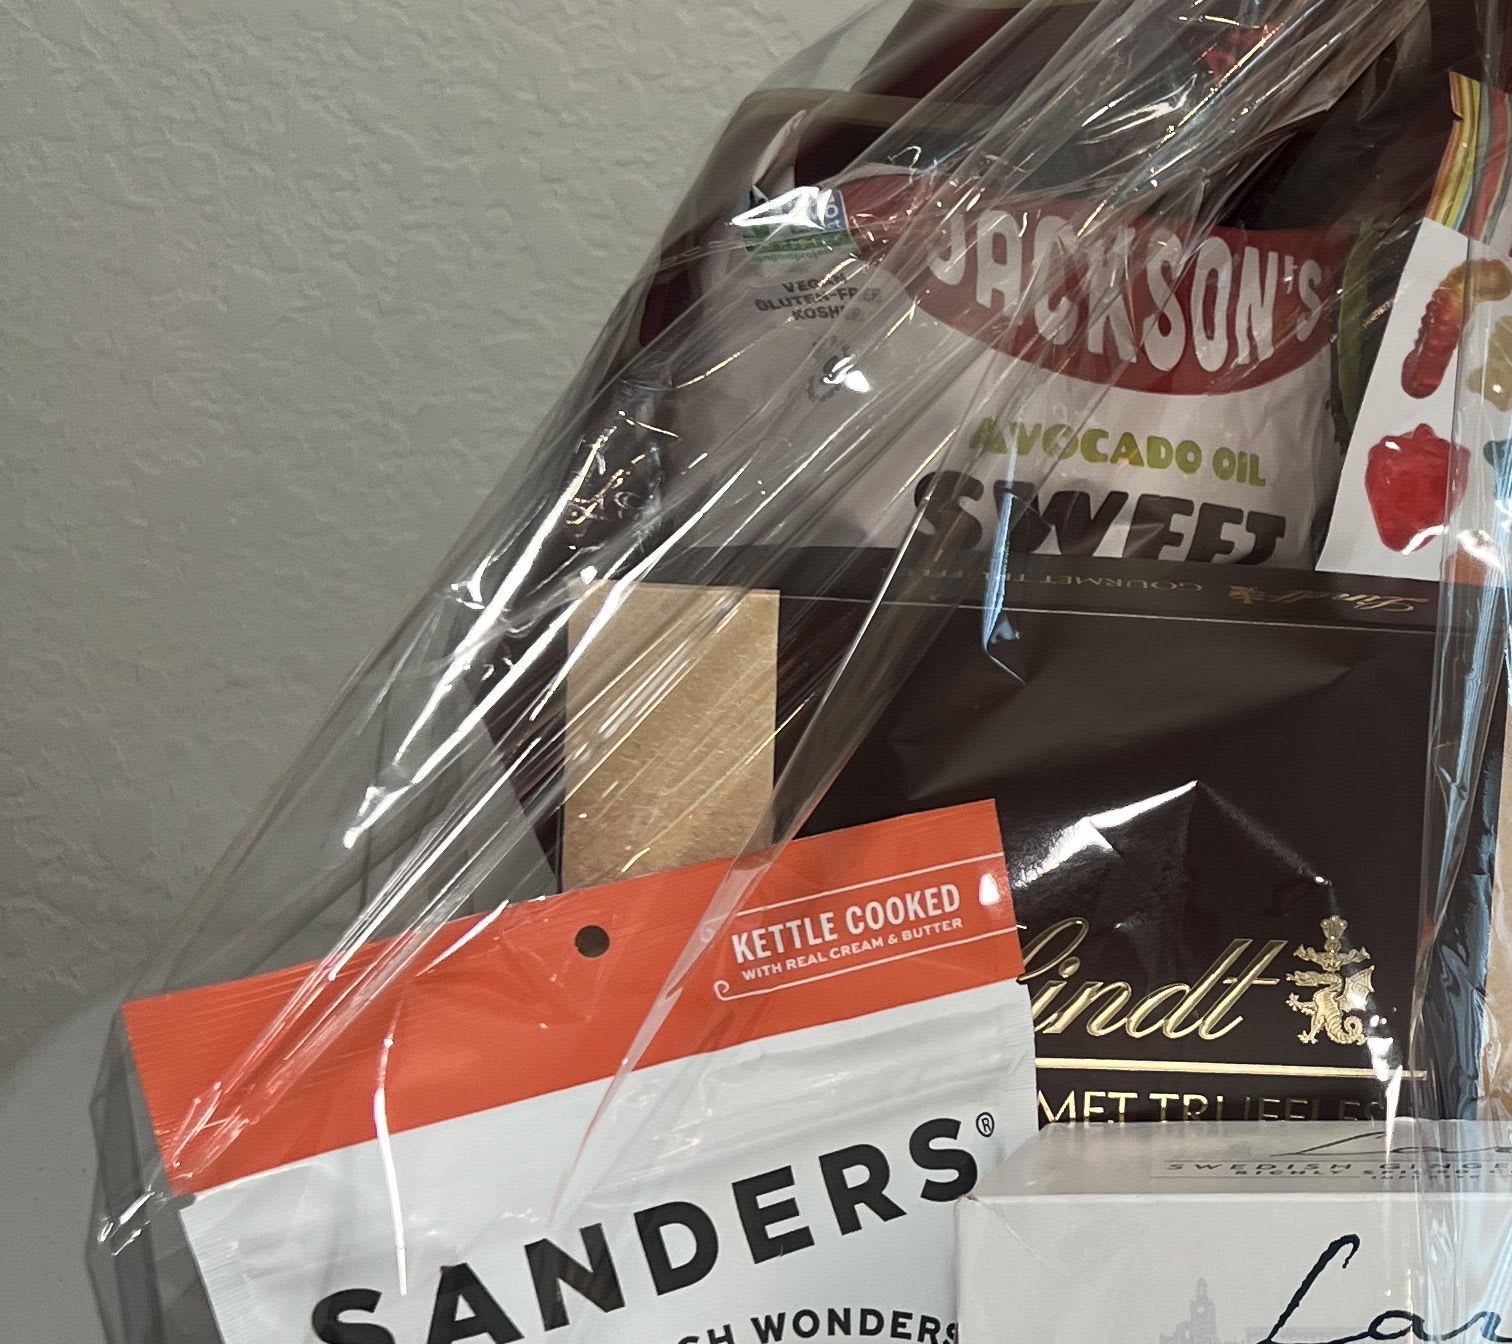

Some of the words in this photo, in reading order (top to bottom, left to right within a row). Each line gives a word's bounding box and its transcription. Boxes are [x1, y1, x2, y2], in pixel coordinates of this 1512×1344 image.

[928, 209, 1324, 372] JACKSON'S
[969, 416, 1203, 474] AVOCADO
[1212, 447, 1266, 486] OIL
[914, 471, 1286, 565] SWEET
[1040, 573, 1203, 592] GOURMET
[731, 912, 838, 964] KETTLE
[845, 883, 961, 936] COOKED
[741, 963, 783, 981] WITH
[785, 951, 829, 971] REAL
[829, 936, 884, 960] CREAM
[887, 933, 899, 945] &
[901, 917, 964, 942] BUTTER
[1167, 1162, 1352, 1171] SWEDISH
